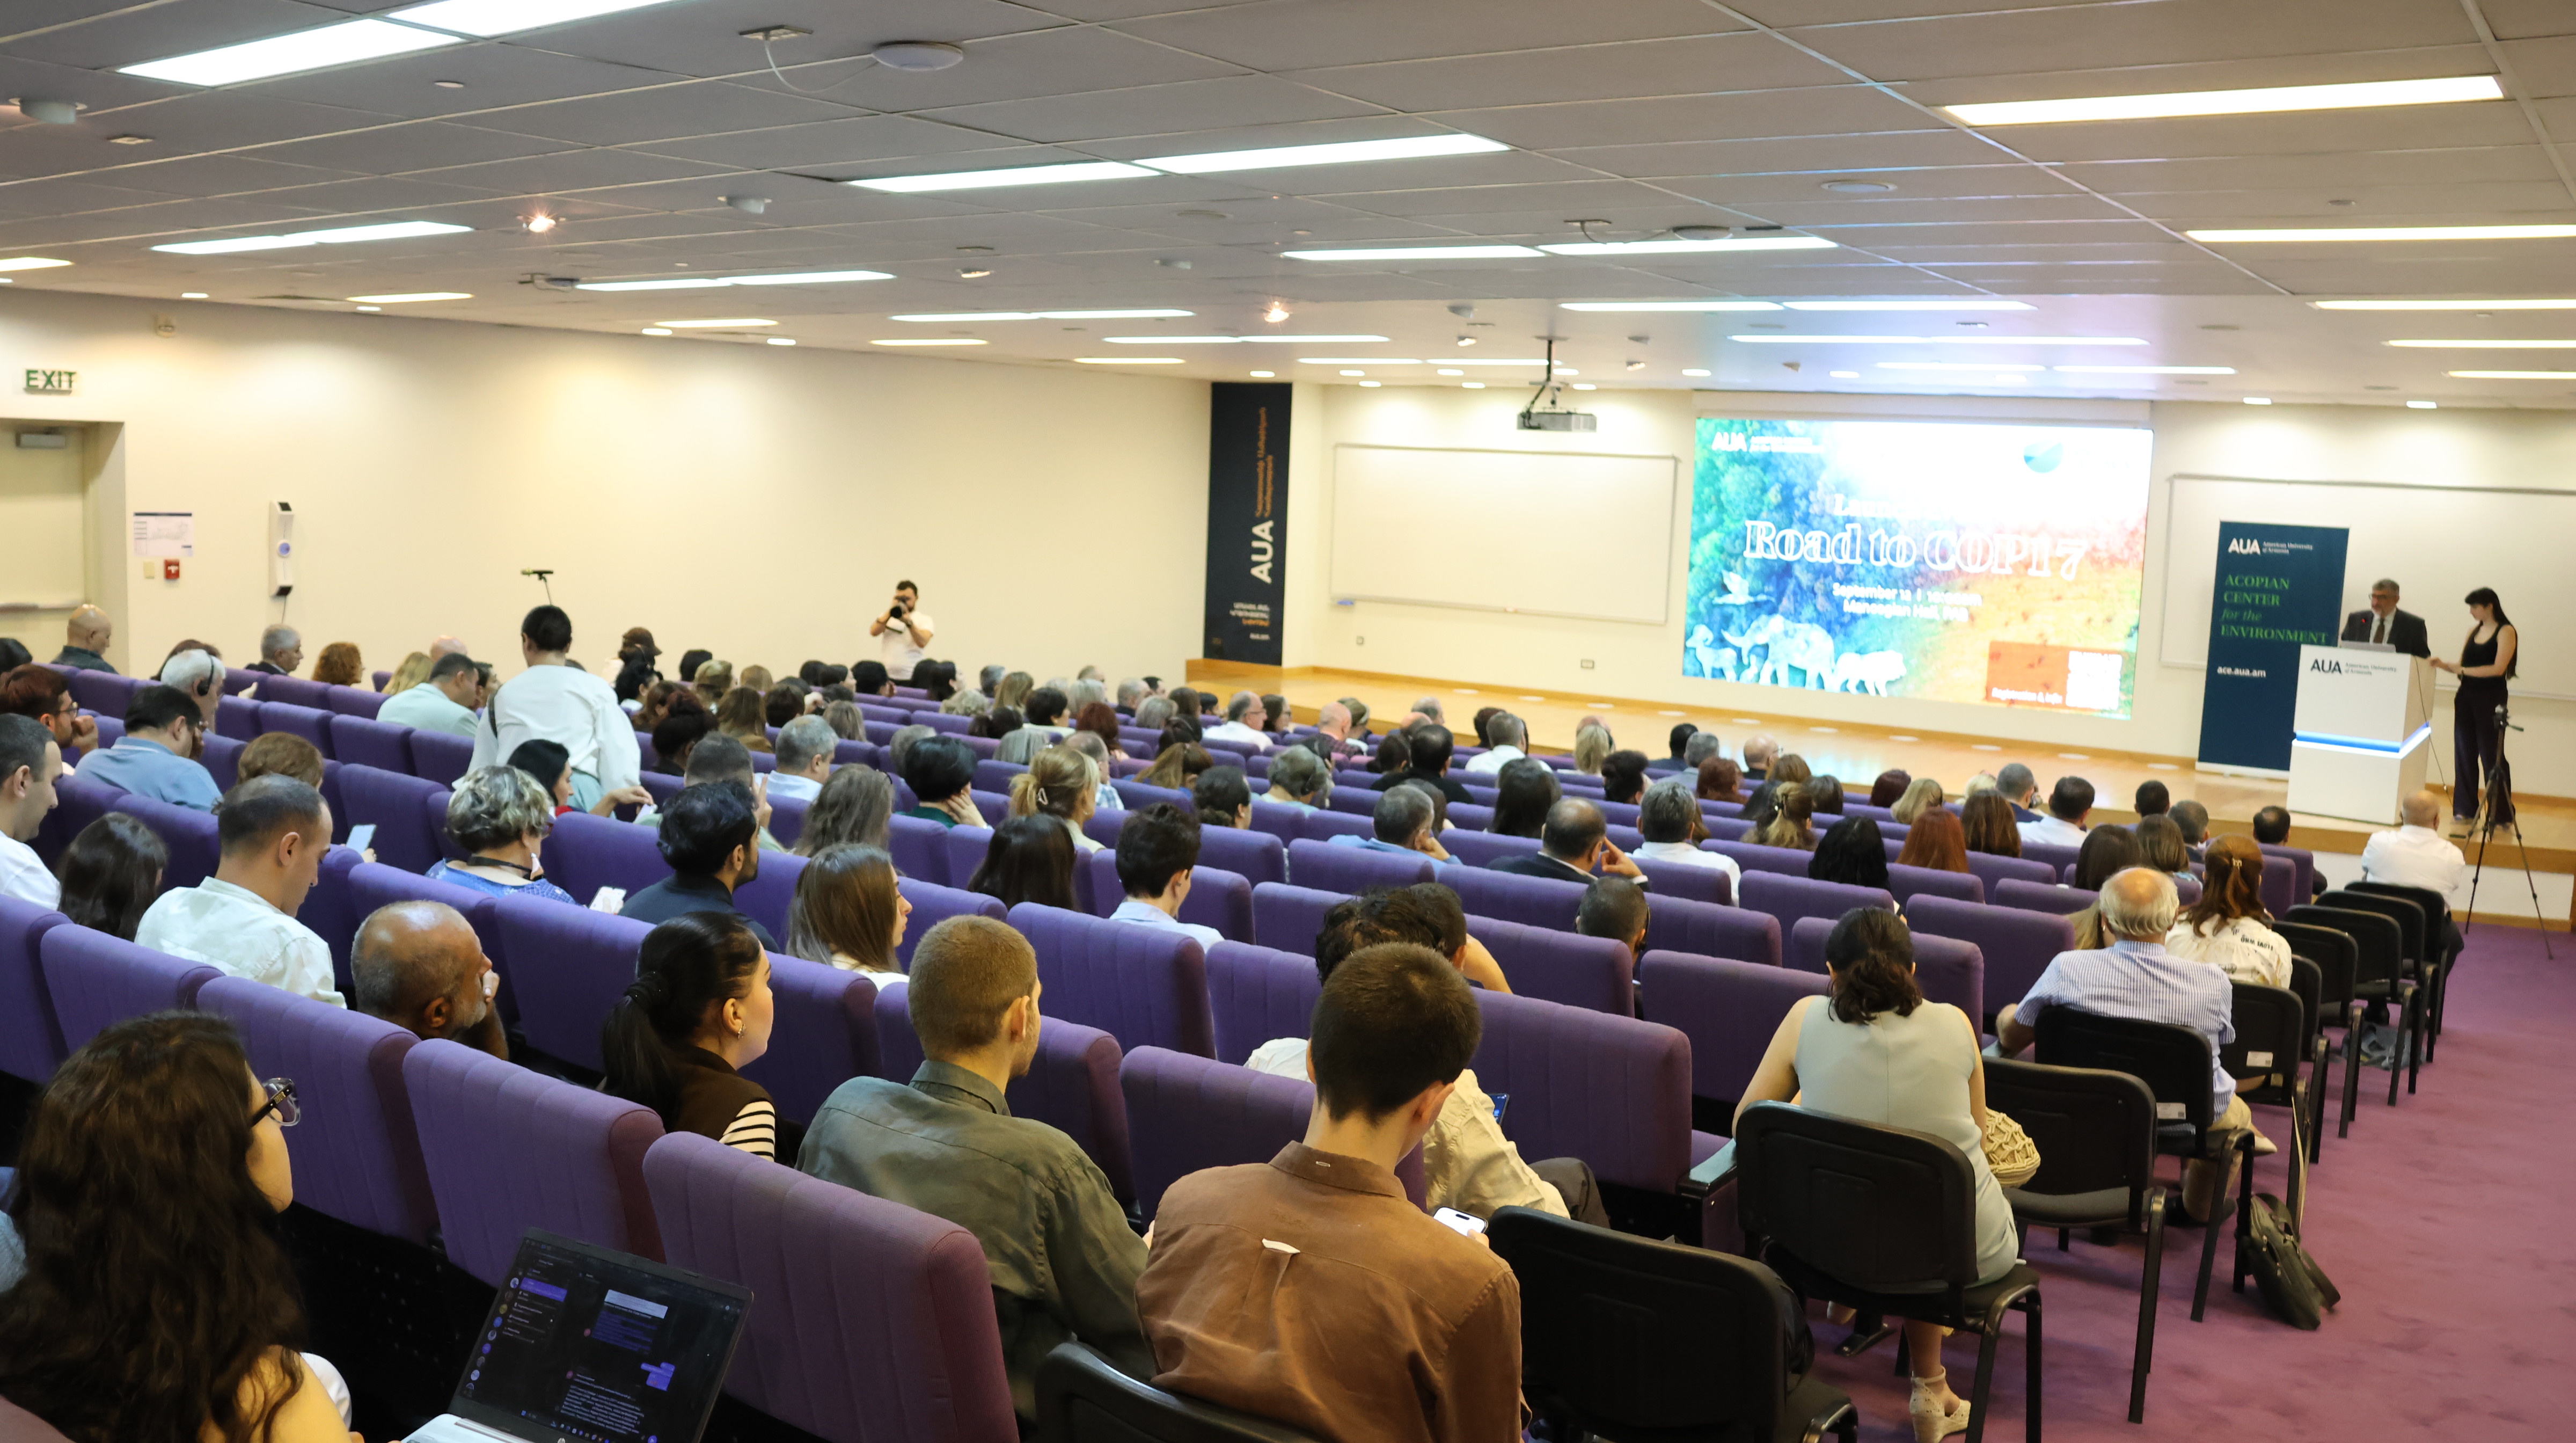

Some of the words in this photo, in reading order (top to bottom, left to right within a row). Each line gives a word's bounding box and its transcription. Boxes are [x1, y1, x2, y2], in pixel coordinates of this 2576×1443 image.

[26, 369, 76, 389] EXIT
[1711, 432, 1747, 452] AUA
[1250, 520, 1274, 584] AUA
[1743, 520, 1862, 565] Road
[1869, 528, 1916, 567] to
[1924, 530, 2089, 581] COP17
[2228, 538, 2260, 555] AUA
[2226, 574, 2289, 589] ACOPIAN
[1833, 582, 1898, 600] September
[2224, 592, 2280, 606] CENTER
[1843, 599, 1911, 618] Manoogian
[2221, 608, 2238, 622] for
[2243, 610, 2263, 621] the
[2221, 624, 2328, 644] ENVIRONMENT
[2217, 666, 2266, 677] ace.aua.am
[2310, 658, 2342, 674] AUA
